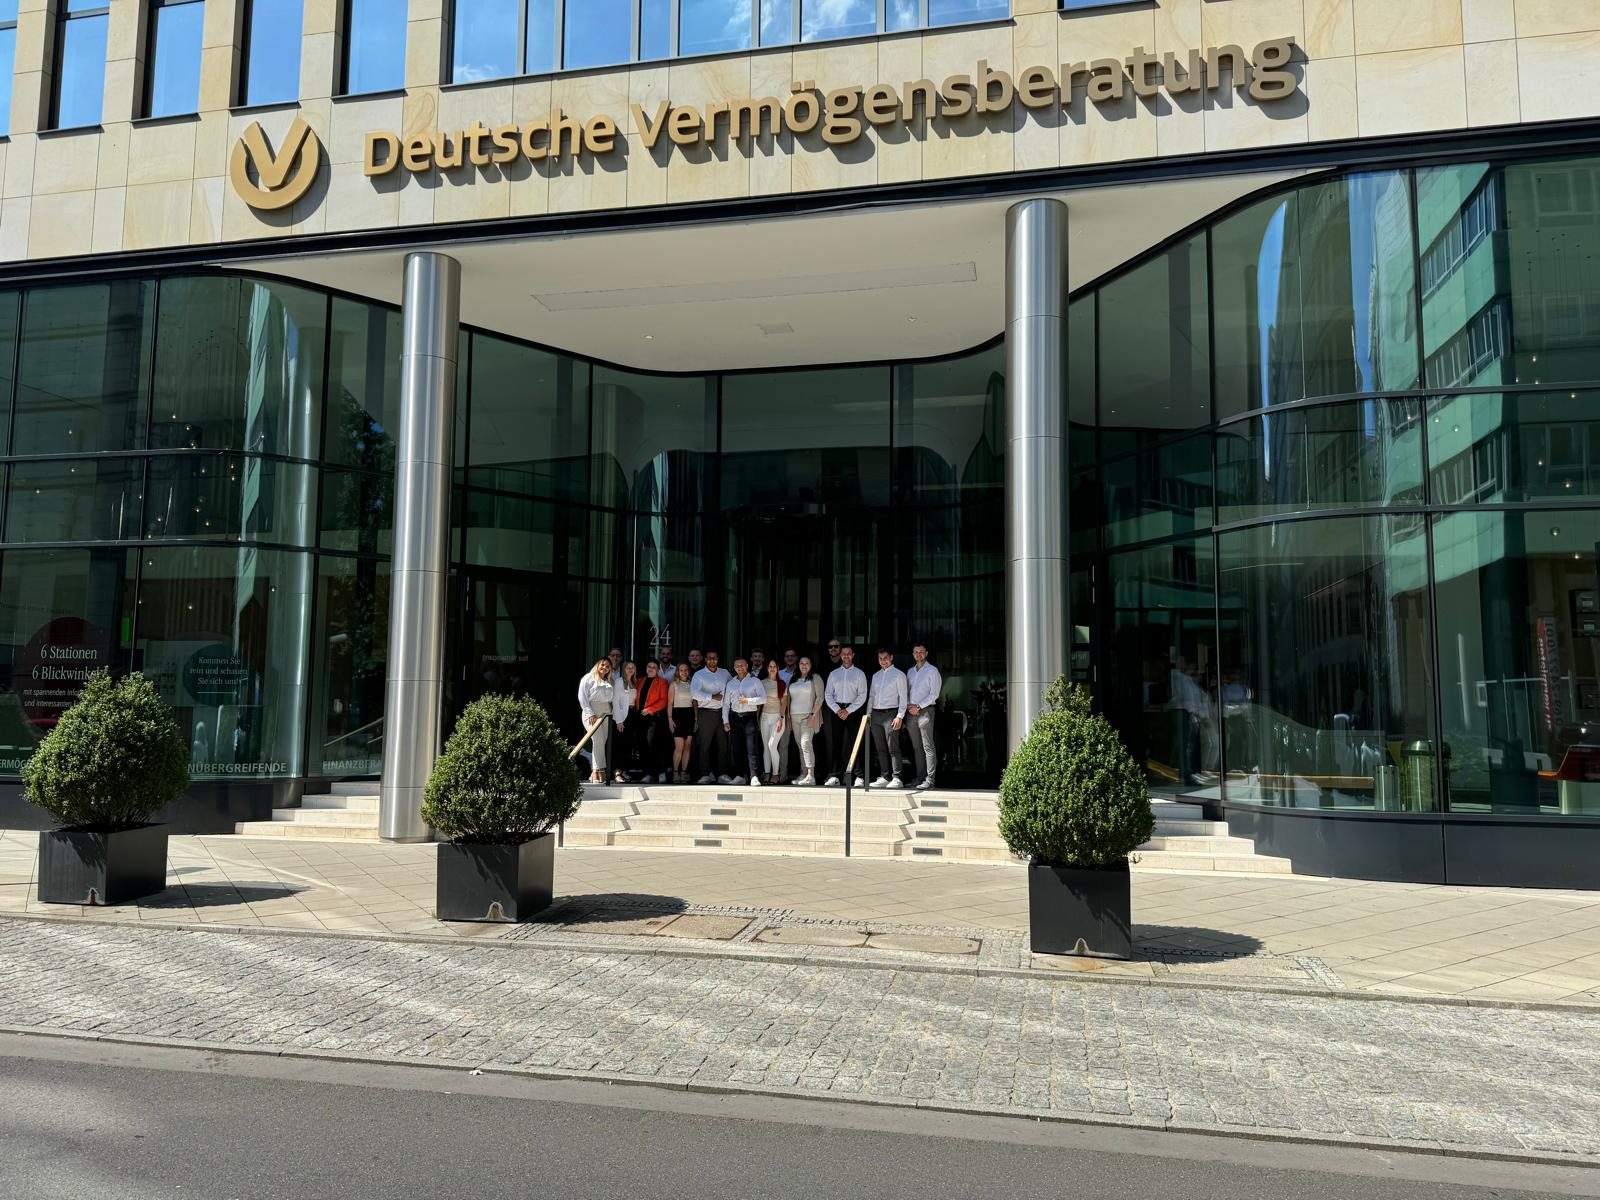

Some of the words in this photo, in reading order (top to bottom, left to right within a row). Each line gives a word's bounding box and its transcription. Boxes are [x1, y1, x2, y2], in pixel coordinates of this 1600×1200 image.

[363, 108, 617, 178] Deutsche
[631, 36, 1296, 149] Vermögensberatung
[650, 623, 671, 646] 24
[41, 643, 48, 659] 6
[50, 645, 97, 659] Stationen
[230, 656, 241, 664] Sie
[32, 664, 39, 680] 6
[205, 666, 219, 674] und
